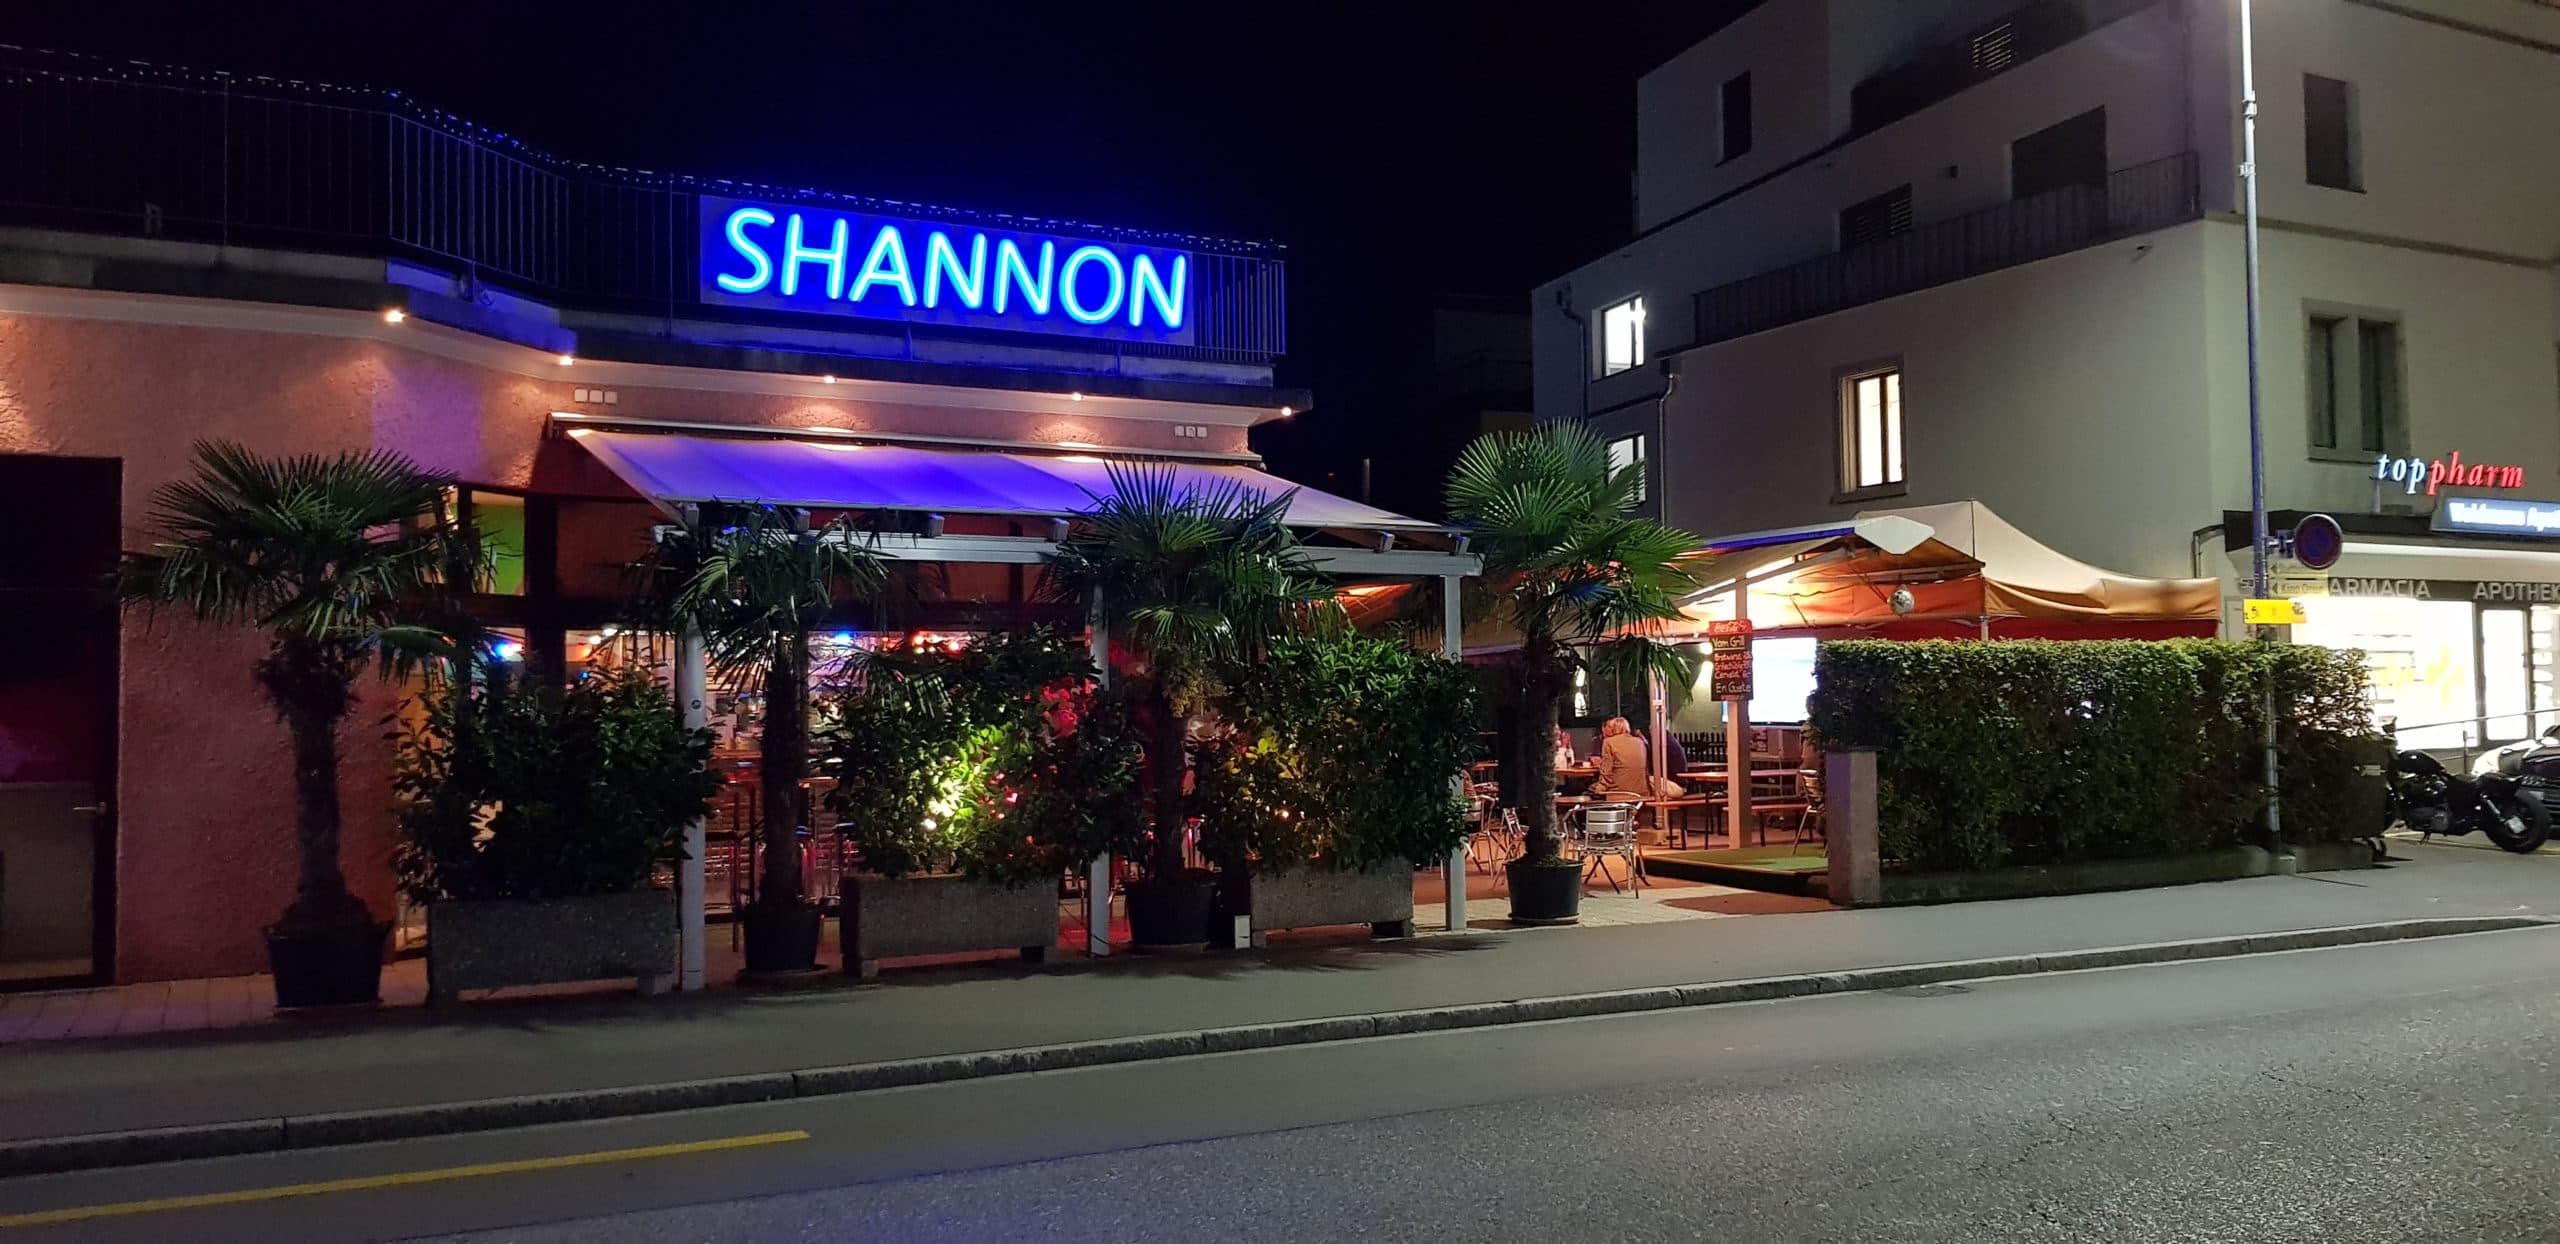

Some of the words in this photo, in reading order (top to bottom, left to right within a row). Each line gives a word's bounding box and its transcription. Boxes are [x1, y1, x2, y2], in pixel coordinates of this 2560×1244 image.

[715, 206, 1187, 329] SHANNON
[2377, 450, 2524, 496] toppharm
[2329, 578, 2432, 598] ARMACIA
[1712, 636, 1729, 648] Vom
[1730, 635, 1745, 647] Grill
[1715, 682, 1728, 693] En
